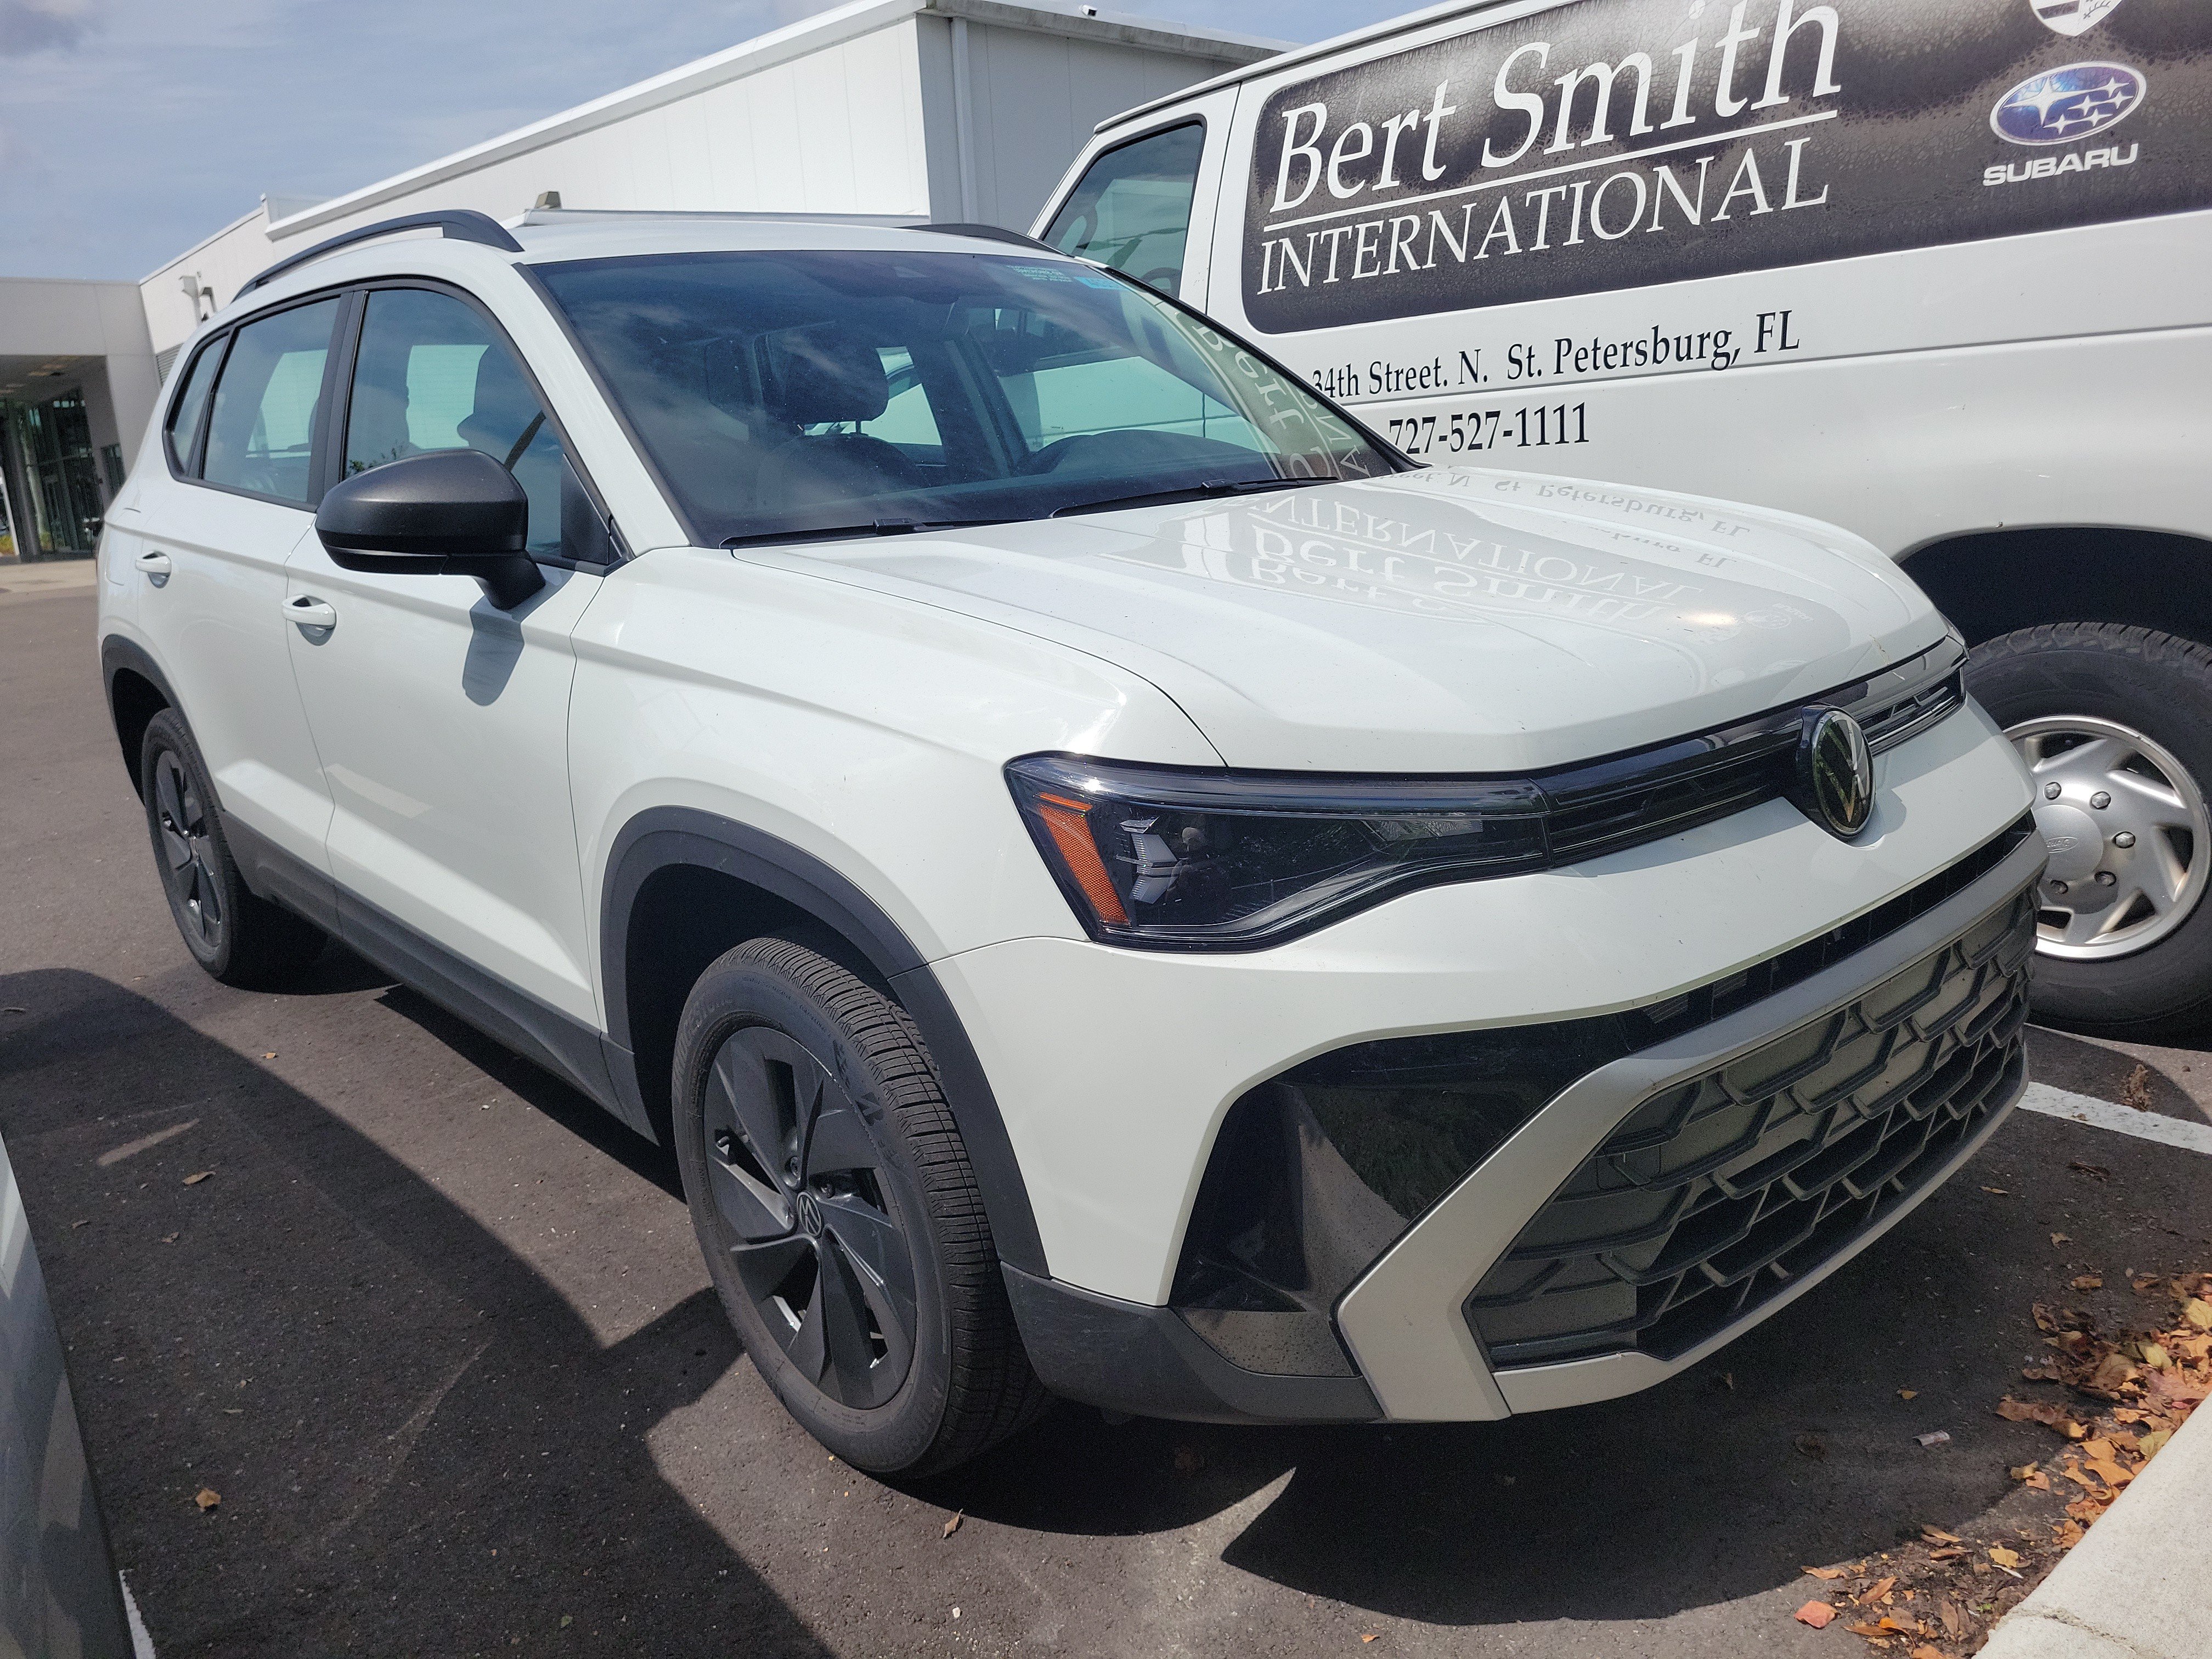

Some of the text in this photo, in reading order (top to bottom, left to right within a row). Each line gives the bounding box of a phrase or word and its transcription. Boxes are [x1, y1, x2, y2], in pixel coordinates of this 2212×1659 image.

[1269, 0, 1841, 213] Bert Smith
[1983, 144, 2138, 187] SUBARU
[1257, 137, 1829, 295] INTERNATIONAL
[1312, 309, 1801, 398] 34th Street. N. St. Petersburg, FL
[1389, 401, 1590, 454] 727-527-1111
